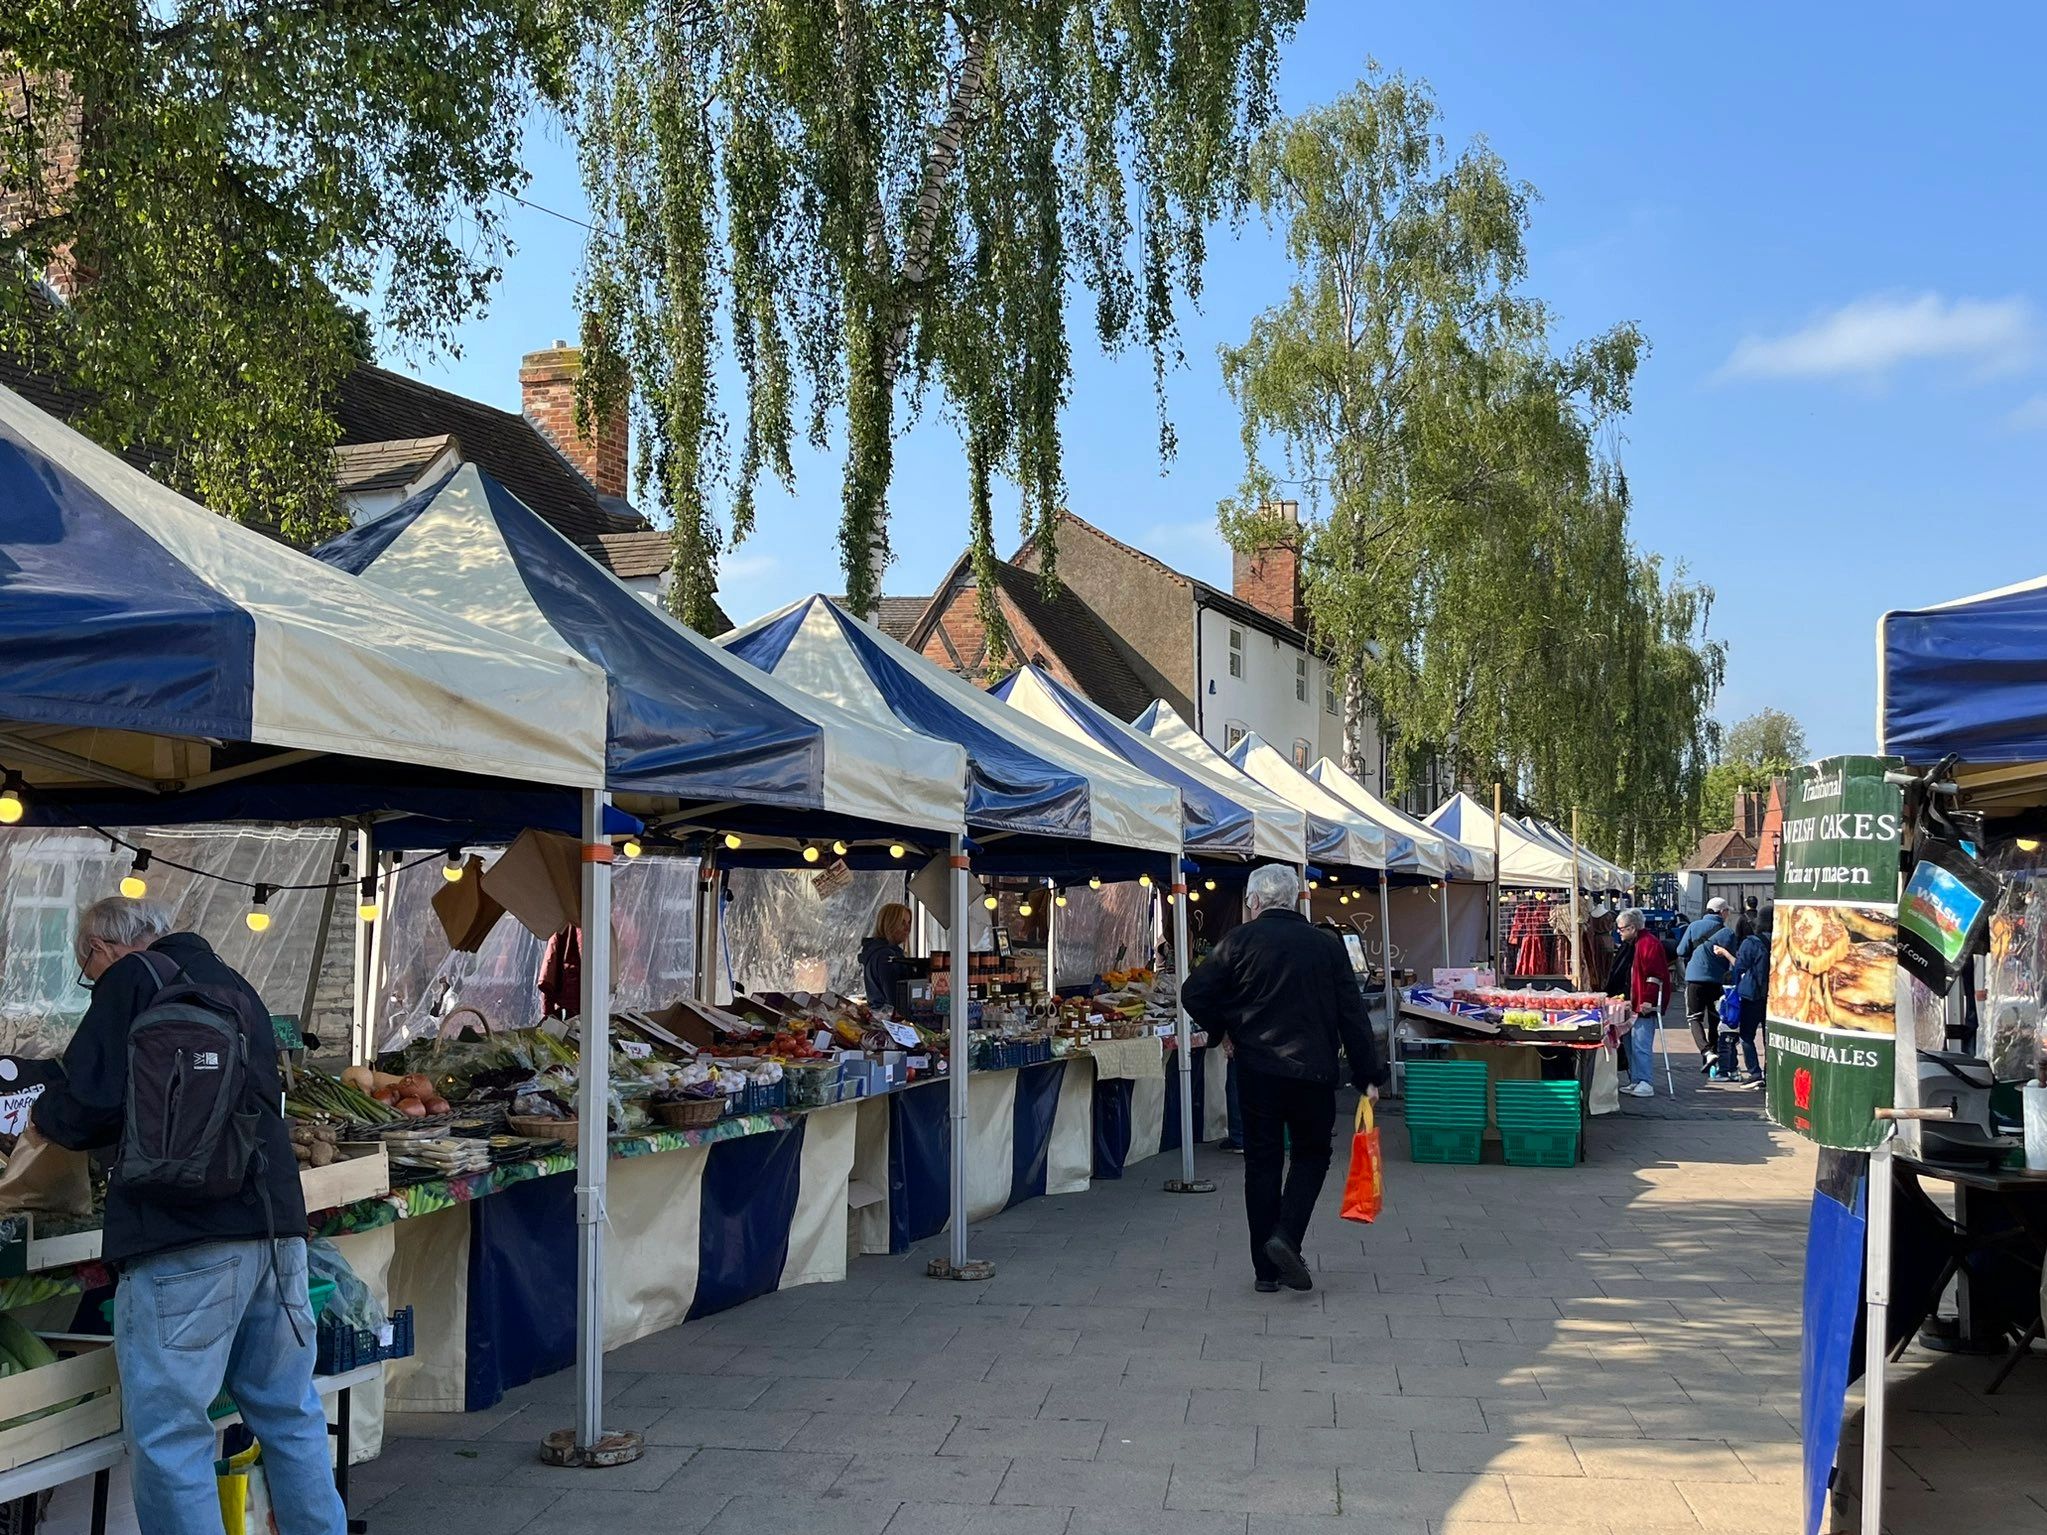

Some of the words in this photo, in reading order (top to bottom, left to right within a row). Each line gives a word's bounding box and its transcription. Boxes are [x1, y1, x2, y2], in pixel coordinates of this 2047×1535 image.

[1782, 817, 1815, 844] WELSH
[1820, 814, 1896, 840] CAKES
[1821, 866, 1871, 884] maen
[1917, 886, 1962, 928] WELSH
[1820, 1045, 1878, 1067] WALES
